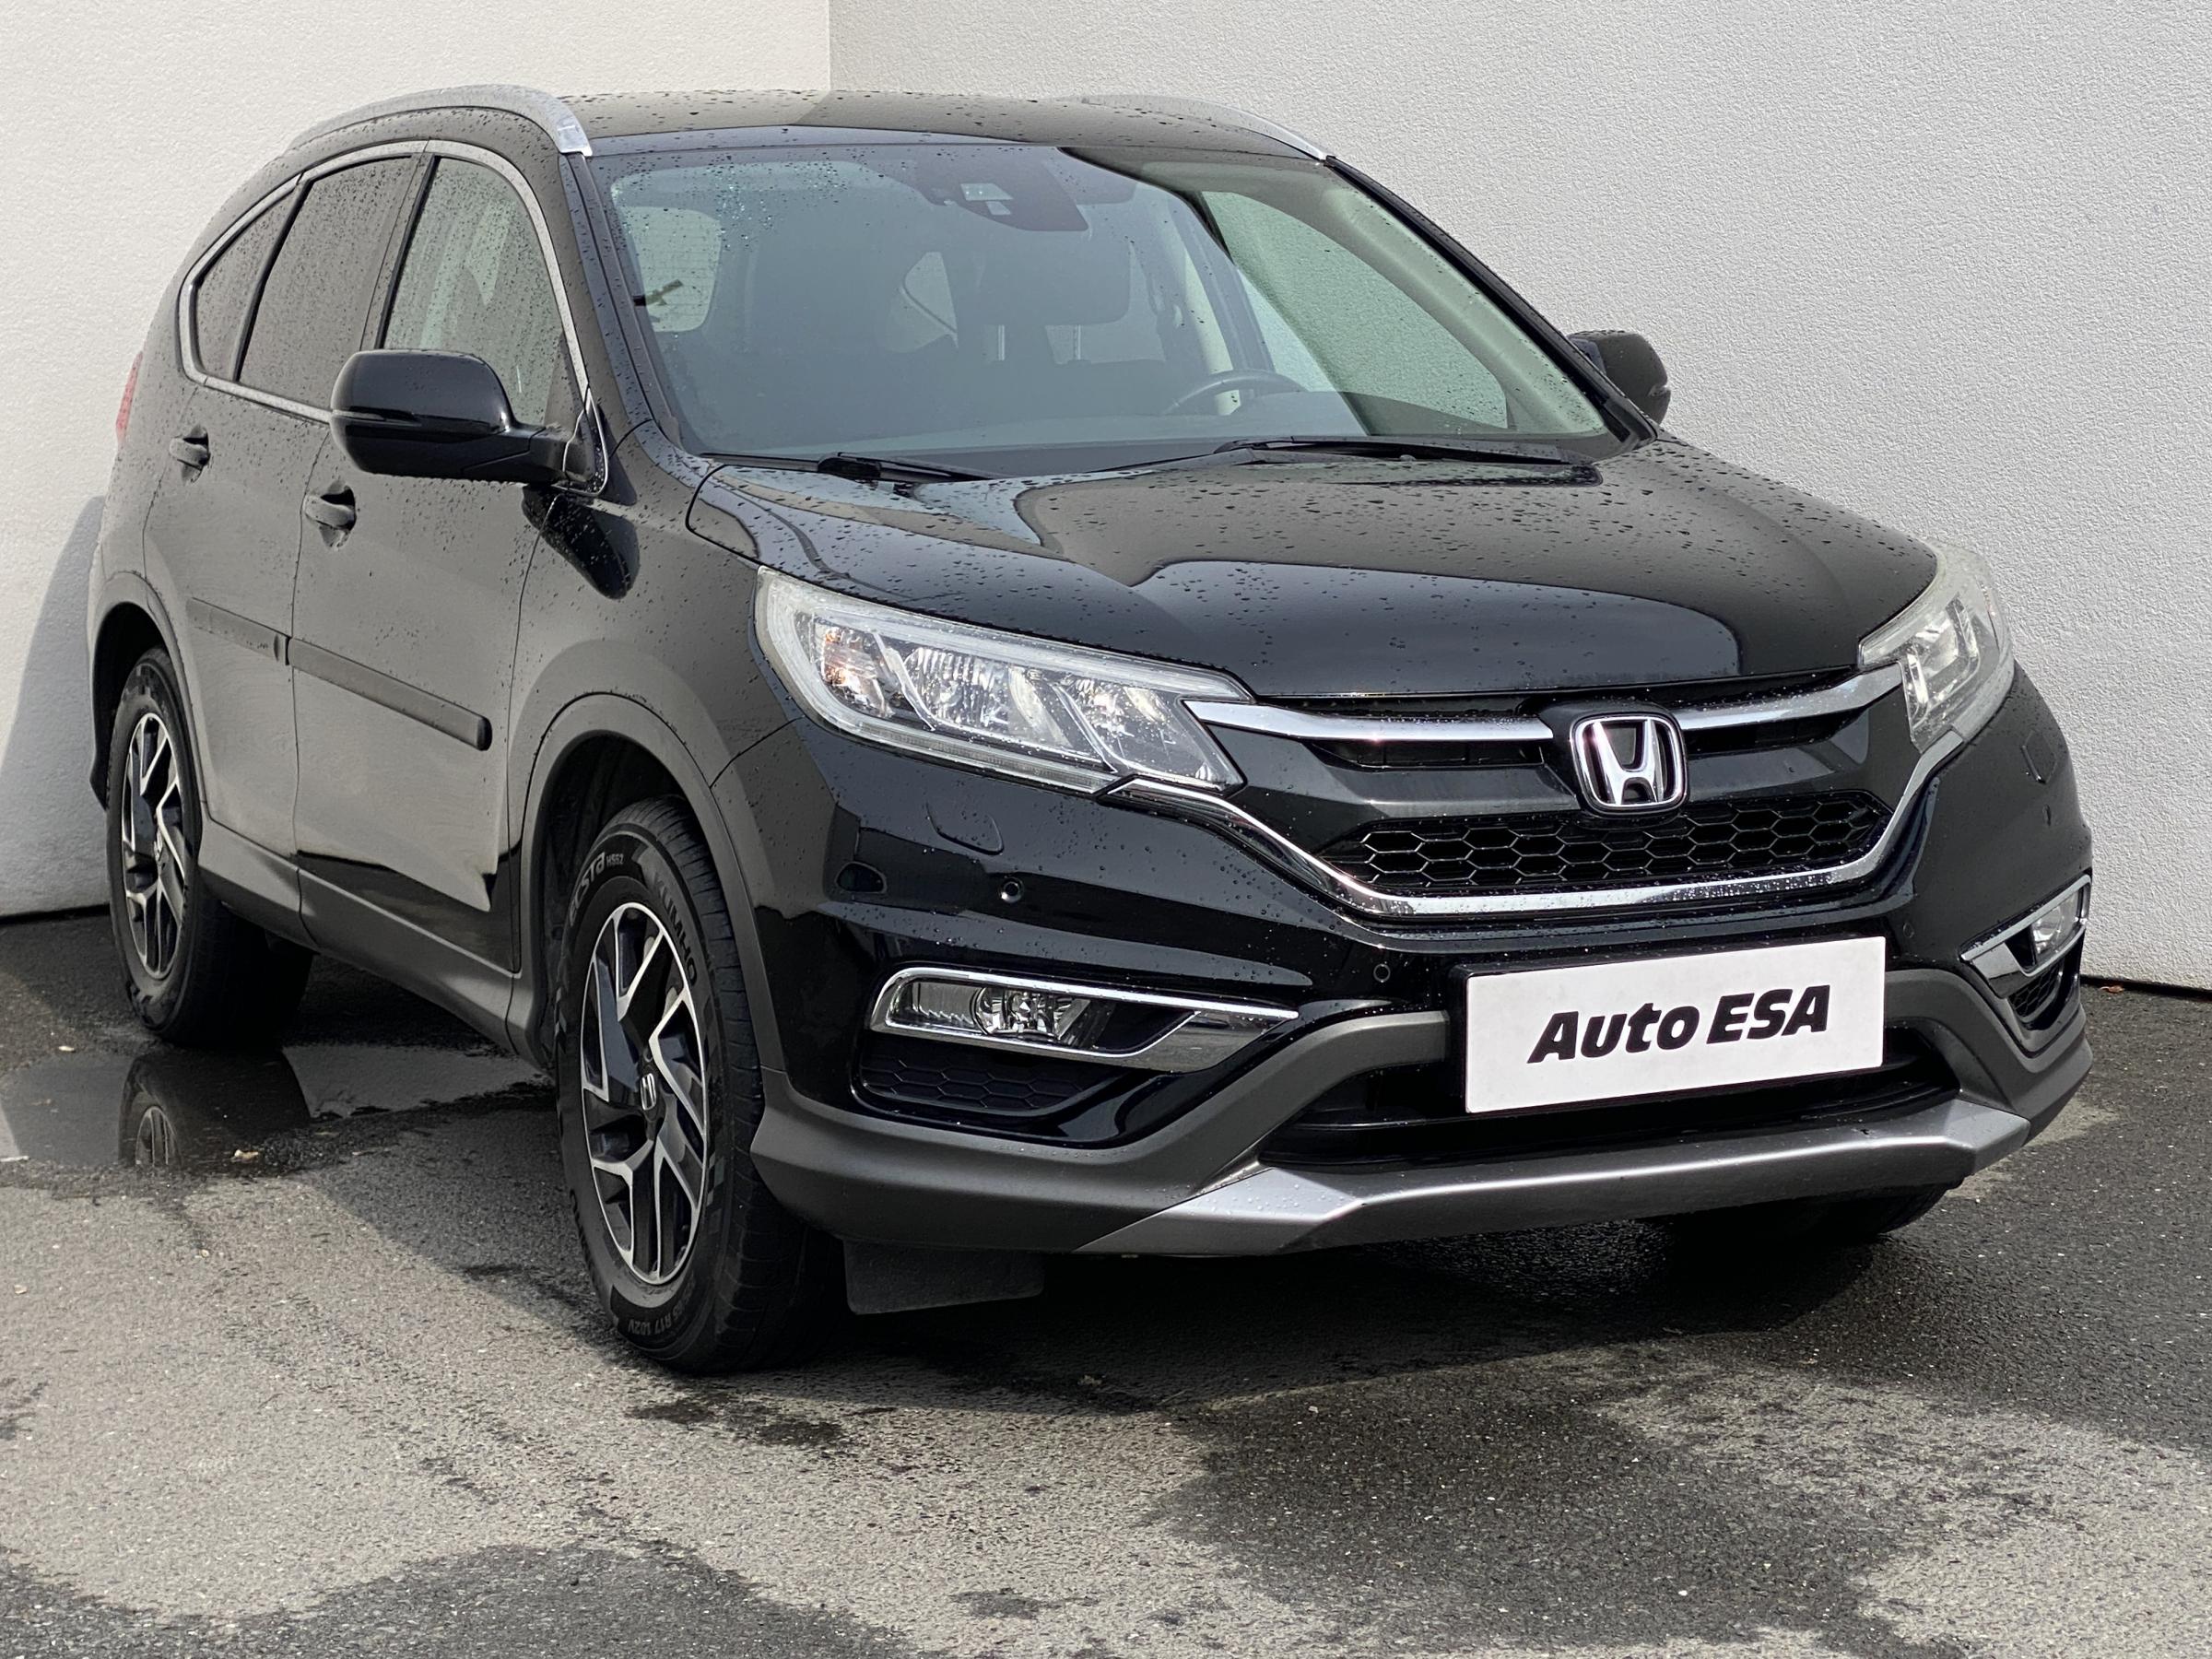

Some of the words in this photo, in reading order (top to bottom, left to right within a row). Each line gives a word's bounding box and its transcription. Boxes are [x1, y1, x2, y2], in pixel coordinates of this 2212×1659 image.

[653, 872, 698, 986] KUMHO
[1526, 1003, 1700, 1064] Auto
[1707, 984, 1830, 1044] ESA
